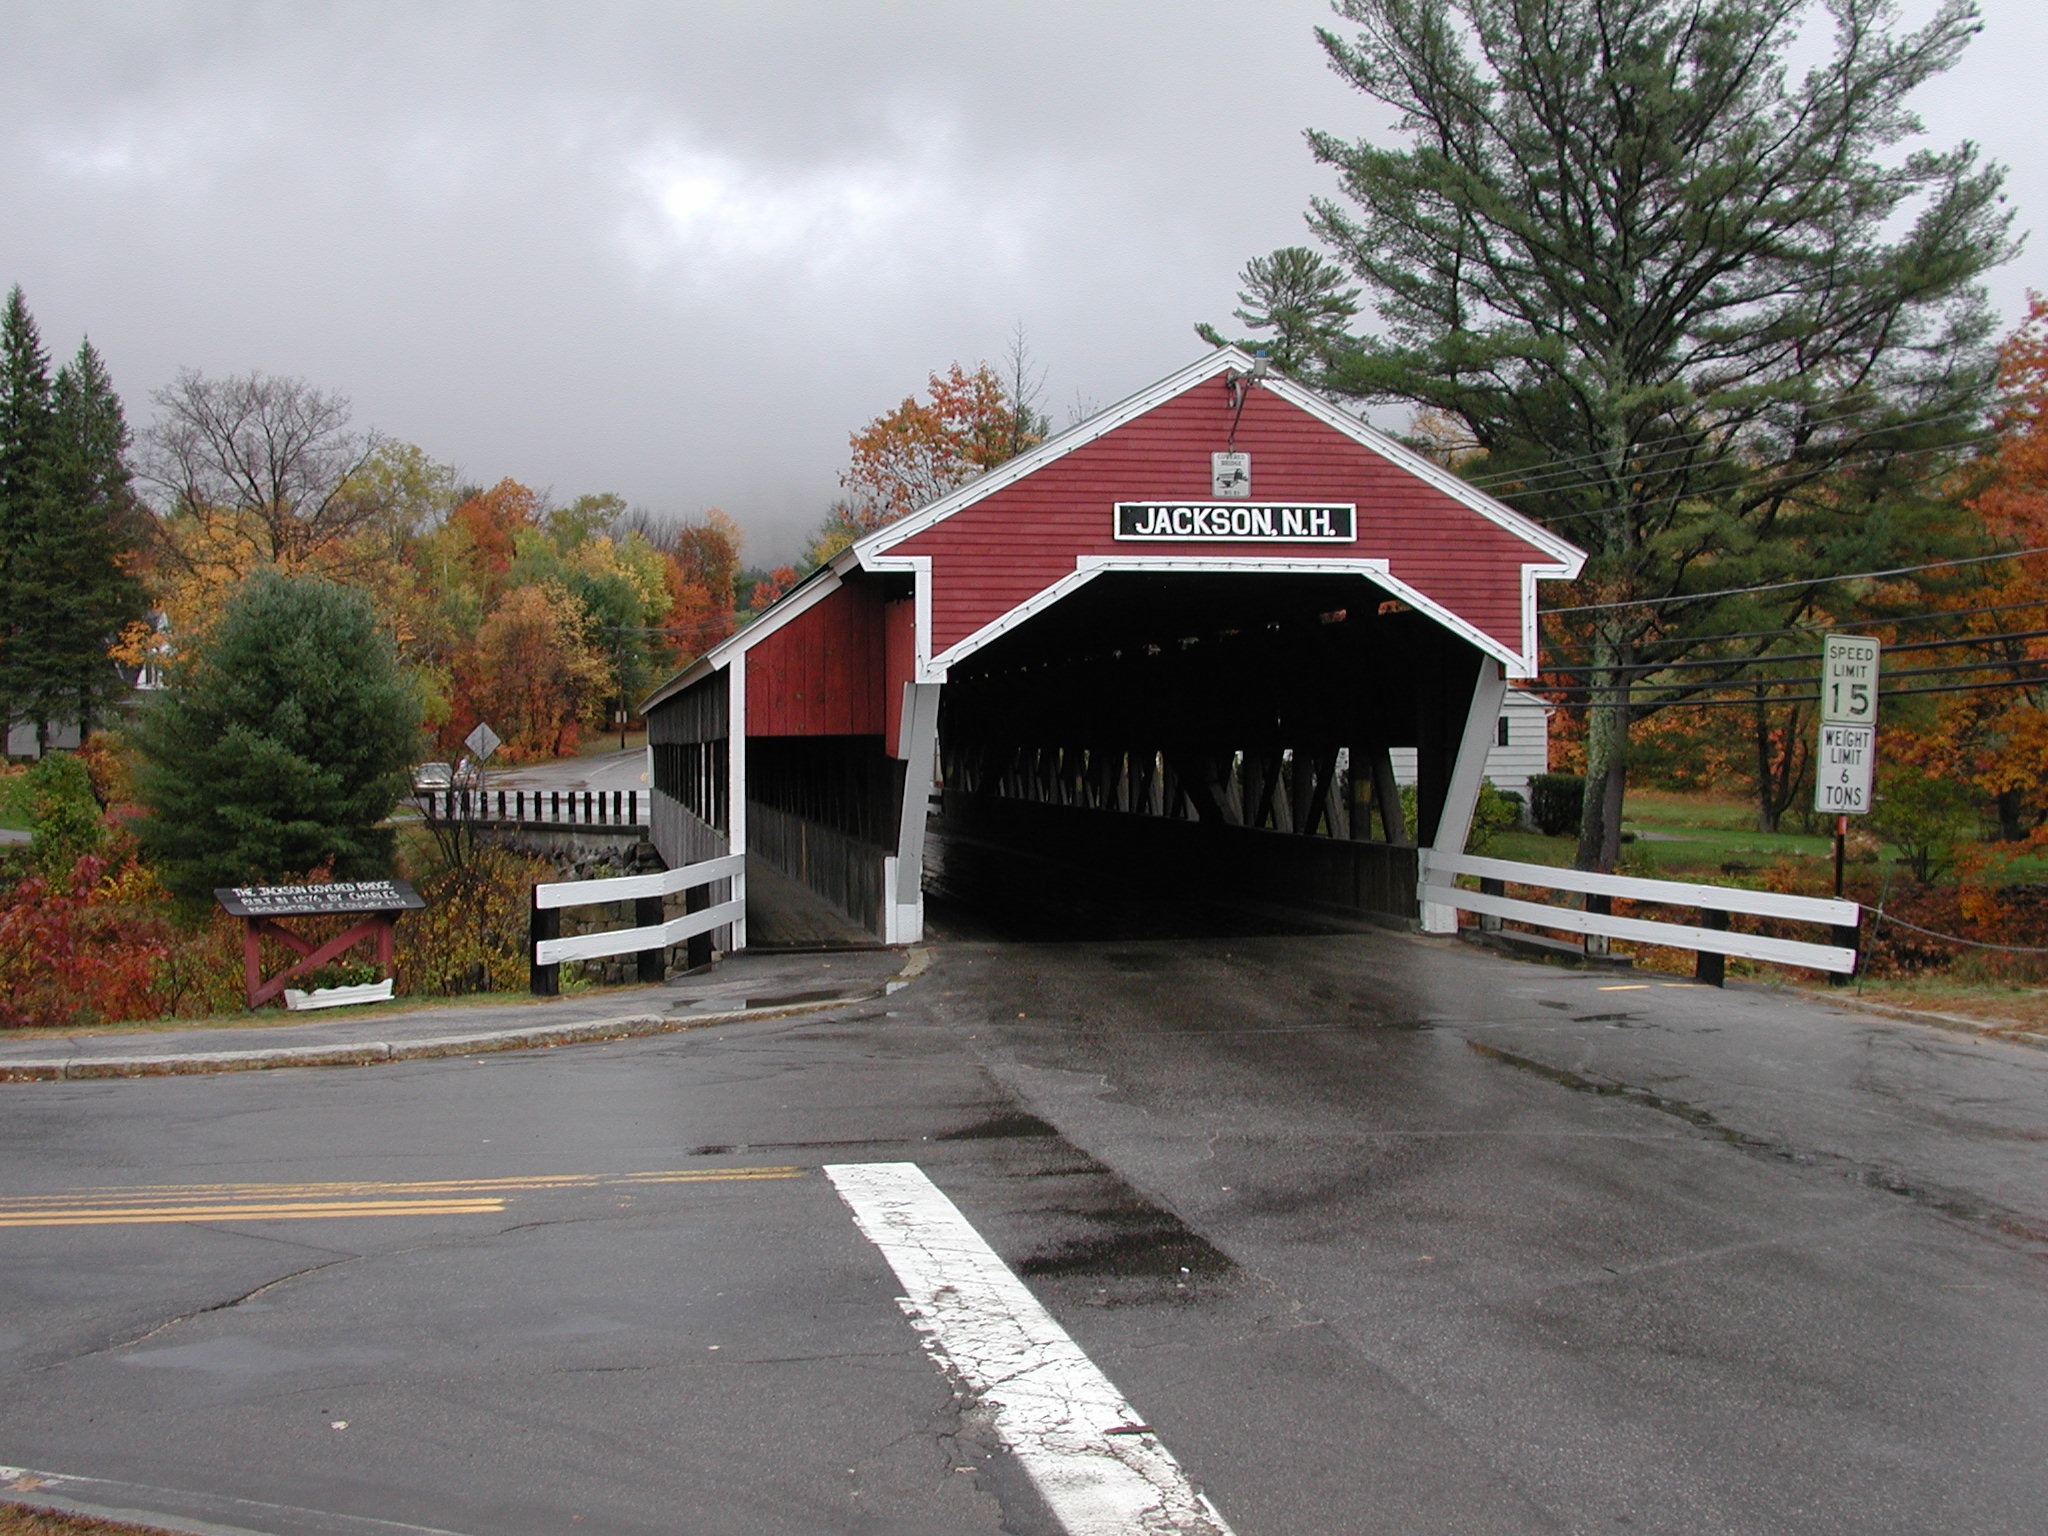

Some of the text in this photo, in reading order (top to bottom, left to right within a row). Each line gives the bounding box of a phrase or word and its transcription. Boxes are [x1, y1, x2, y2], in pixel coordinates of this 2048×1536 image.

[1135, 508, 1336, 537] JACKSON, N.H.
[1830, 645, 1874, 661] SPEED
[1833, 664, 1868, 678] LIMIT
[1831, 682, 1869, 716] 15
[1825, 729, 1871, 748] WEIGHT
[1831, 748, 1863, 765] LIMIT
[1840, 768, 1850, 784] 6
[1826, 786, 1862, 806] TONS
[232, 881, 394, 897] THE JACKSON COVERED BRIDGE
[240, 890, 400, 906] BUILT IN 1876 BY CHARLES
[320, 902, 335, 911] OF
